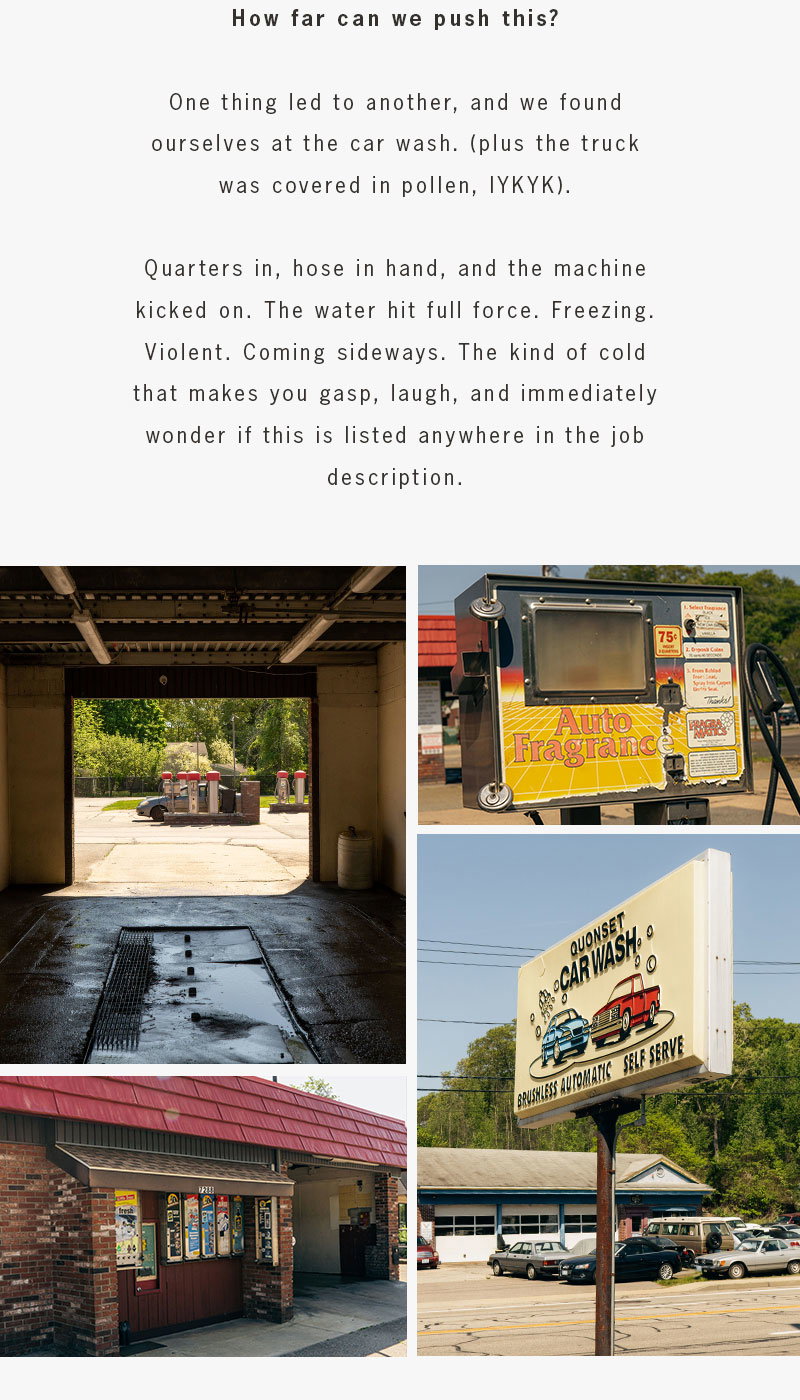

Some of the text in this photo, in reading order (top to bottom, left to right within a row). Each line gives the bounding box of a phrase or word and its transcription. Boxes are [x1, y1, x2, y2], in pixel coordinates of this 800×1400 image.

[658, 631, 678, 643] 75¢
[704, 696, 731, 705] Thanks!
[554, 707, 632, 736] Auto
[513, 733, 674, 768] Fragrance
[570, 911, 625, 957] QUONSET
[560, 926, 637, 991] CAR WASH
[517, 1035, 684, 1108] BRUSHLESS AUTOMATIC SELF SERVE
